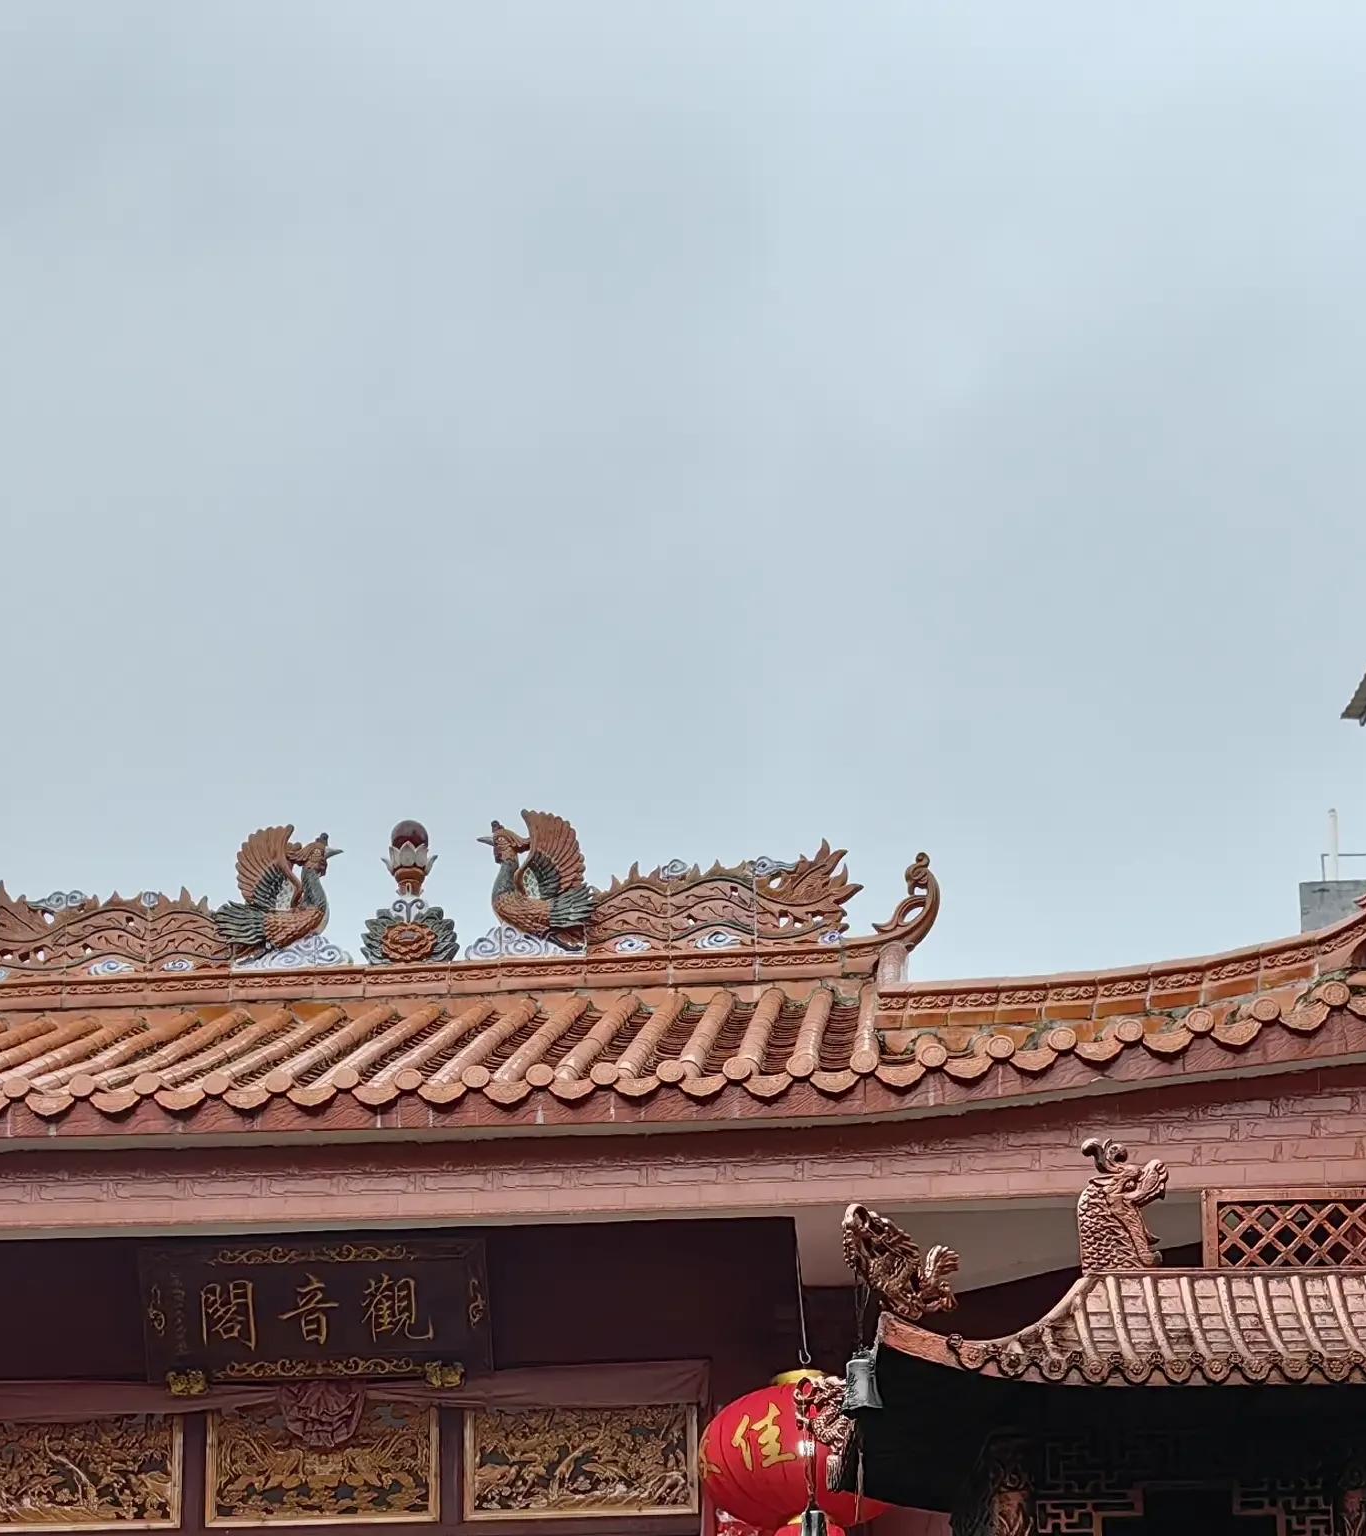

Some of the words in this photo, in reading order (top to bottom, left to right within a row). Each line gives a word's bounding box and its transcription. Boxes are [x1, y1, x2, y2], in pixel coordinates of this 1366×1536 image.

[199, 1273, 434, 1351] 觀音閣
[730, 1402, 797, 1472] 佳
